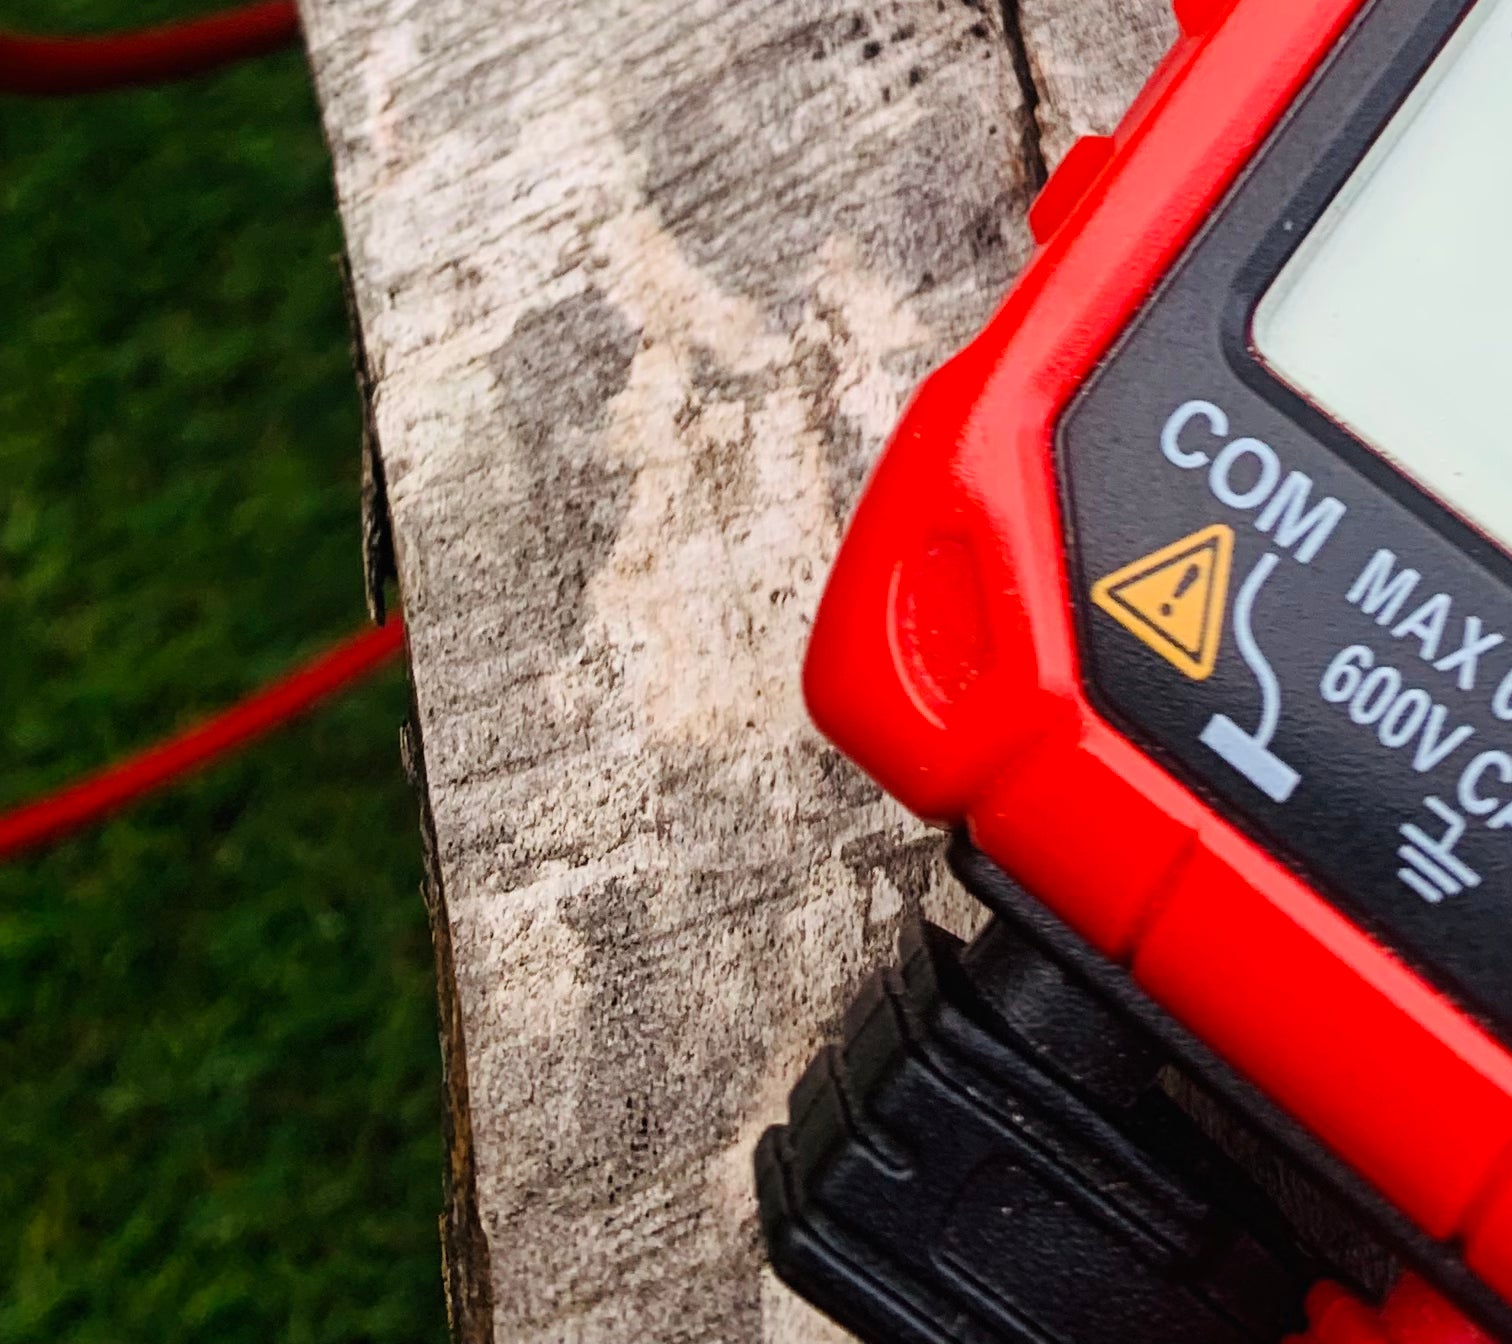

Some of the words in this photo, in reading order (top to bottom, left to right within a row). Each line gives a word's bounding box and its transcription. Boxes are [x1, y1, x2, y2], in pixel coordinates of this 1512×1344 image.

[1159, 398, 1348, 565] COM
[1344, 547, 1504, 691] MAX
[1319, 642, 1476, 776] 600V
